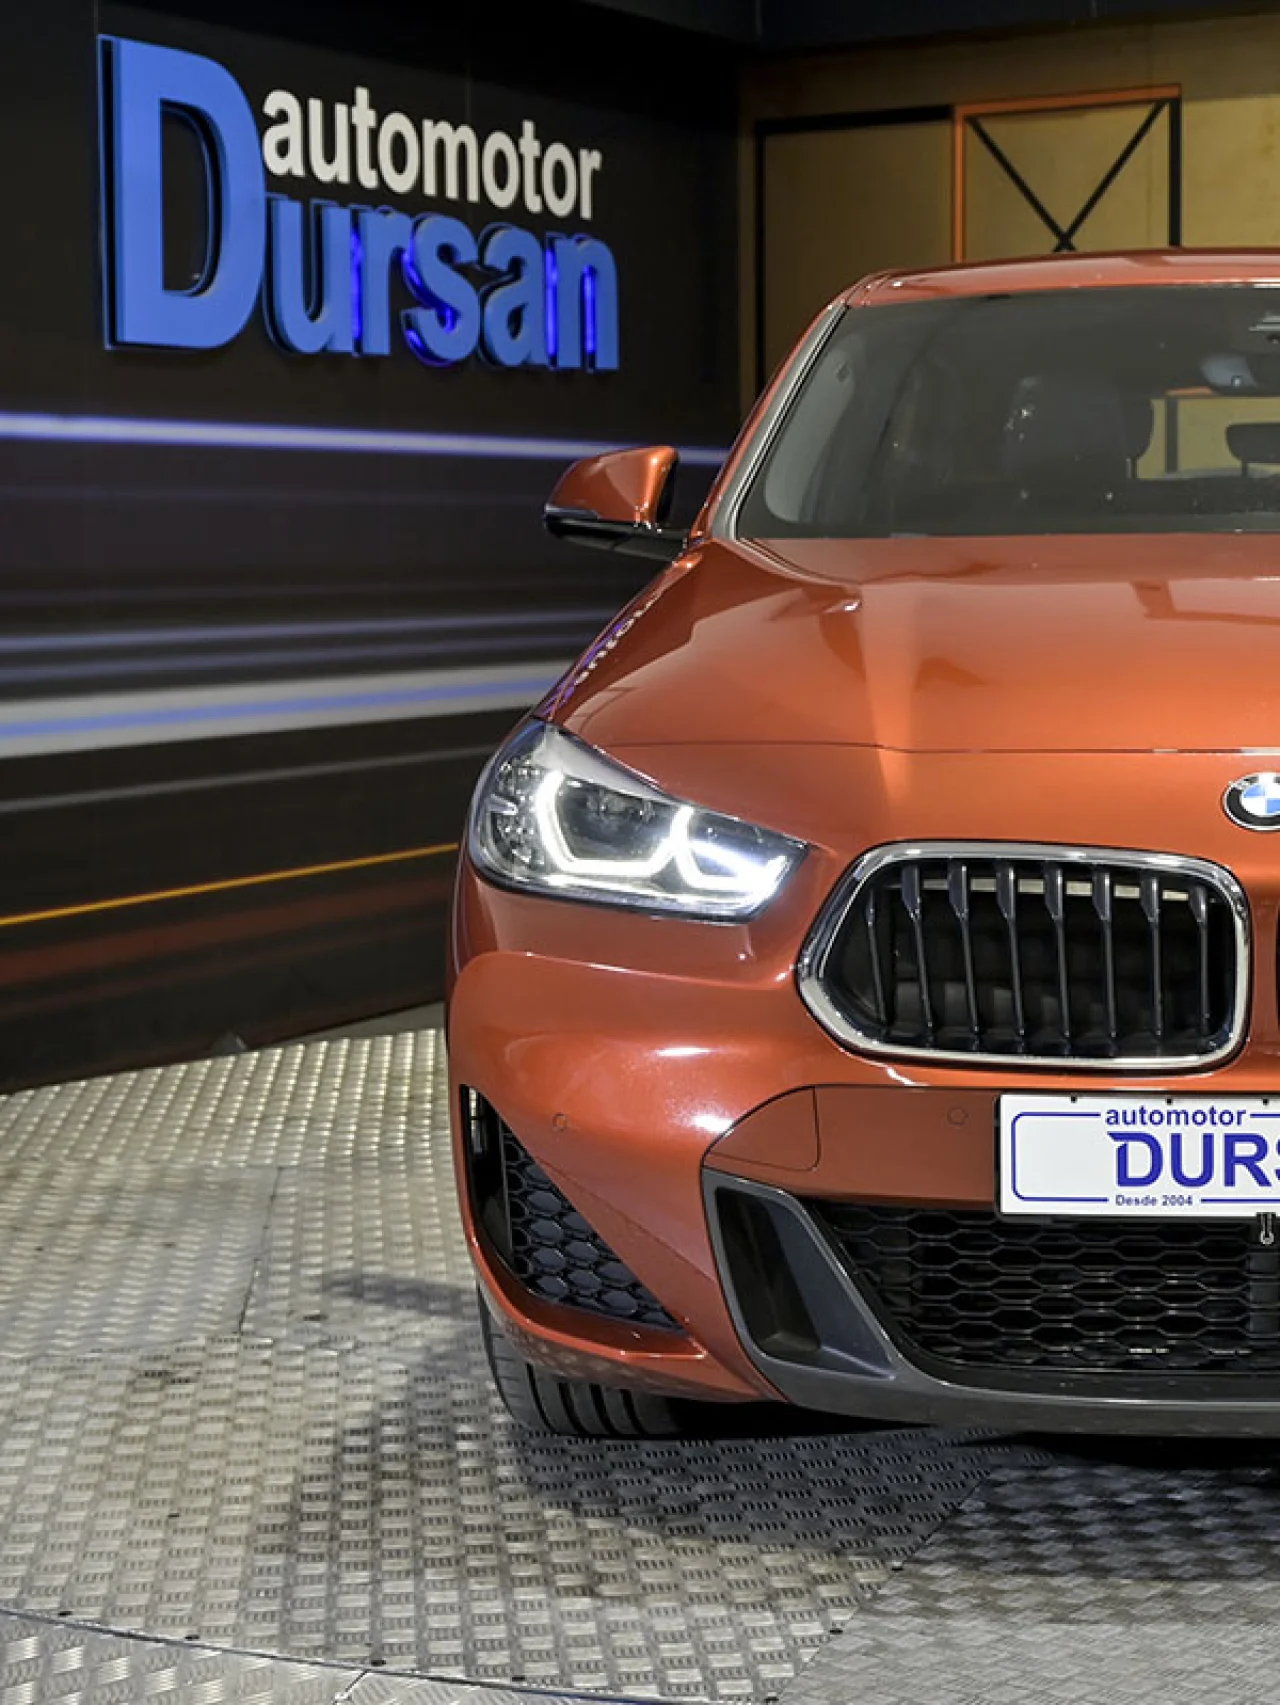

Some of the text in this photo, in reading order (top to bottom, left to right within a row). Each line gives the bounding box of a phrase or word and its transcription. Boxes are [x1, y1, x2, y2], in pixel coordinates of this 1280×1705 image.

[262, 86, 602, 220] automotor
[97, 33, 619, 371] Dursan
[1105, 1104, 1247, 1127] automotor
[1115, 1194, 1157, 1207] Desde
